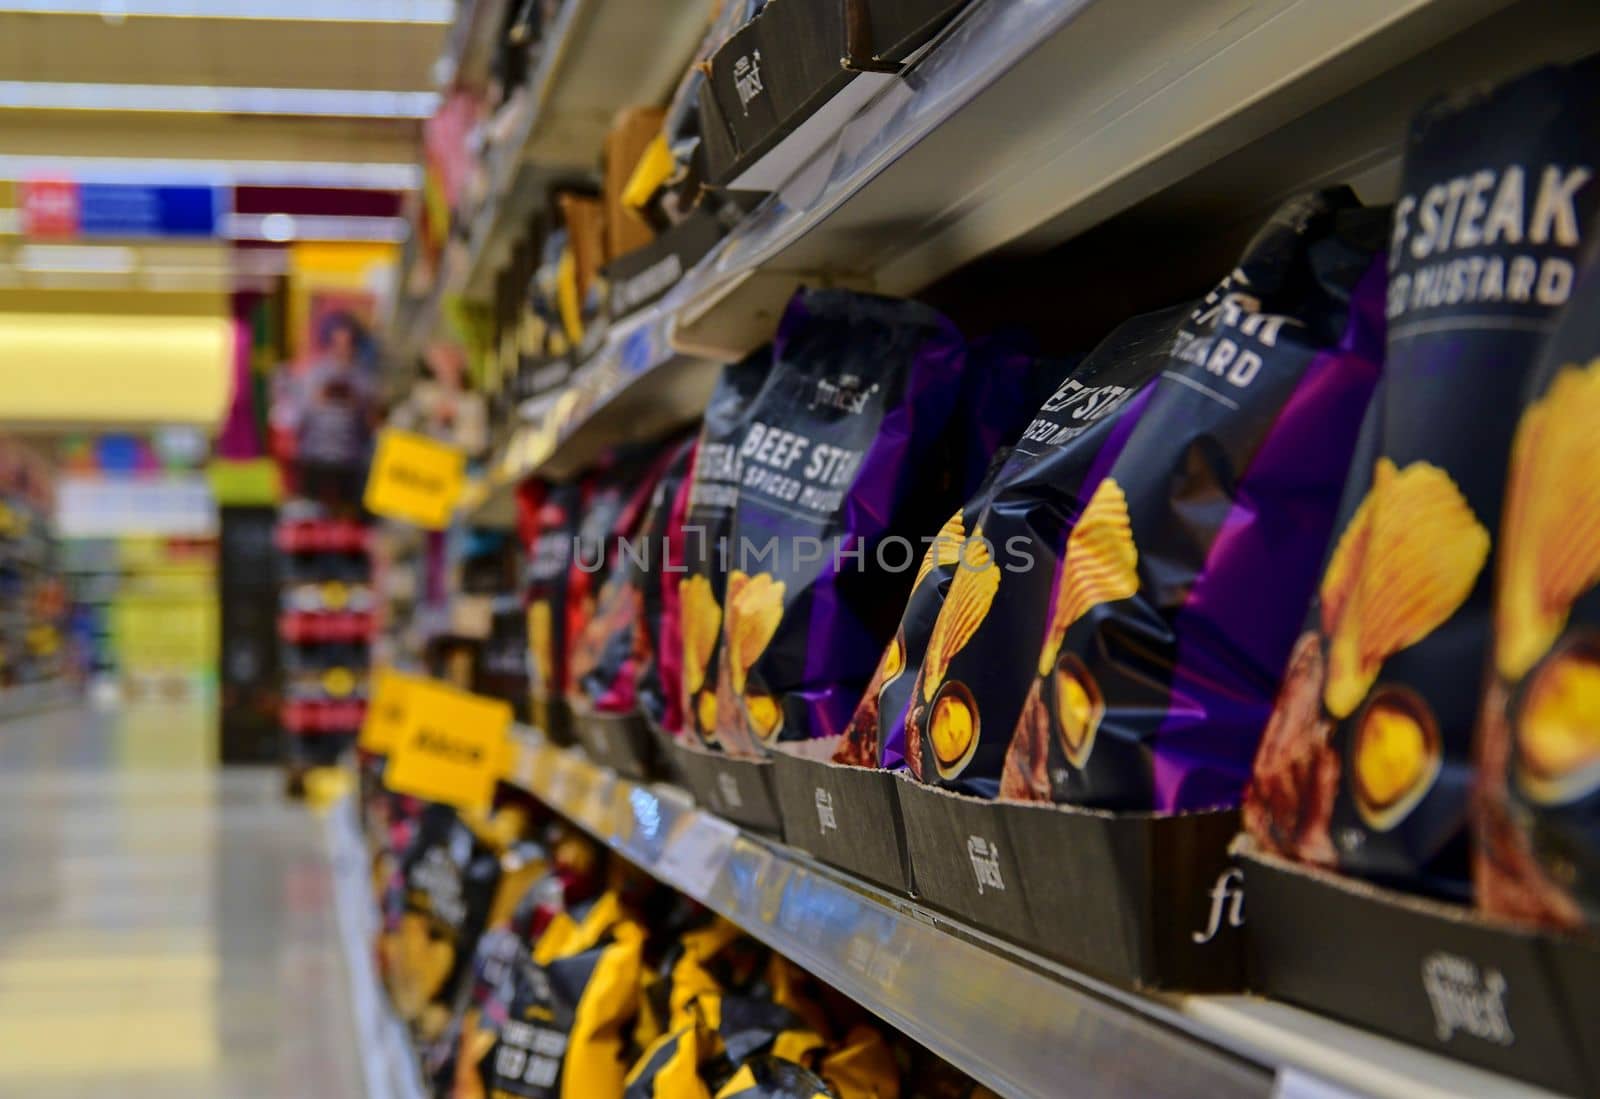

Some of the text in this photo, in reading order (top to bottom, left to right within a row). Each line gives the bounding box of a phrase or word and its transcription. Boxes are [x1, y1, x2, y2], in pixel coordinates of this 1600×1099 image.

[1411, 164, 1590, 259] STEAK
[1412, 255, 1574, 310] MUSTARD
[741, 421, 809, 471] BEEF
[742, 467, 801, 501] SPICED
